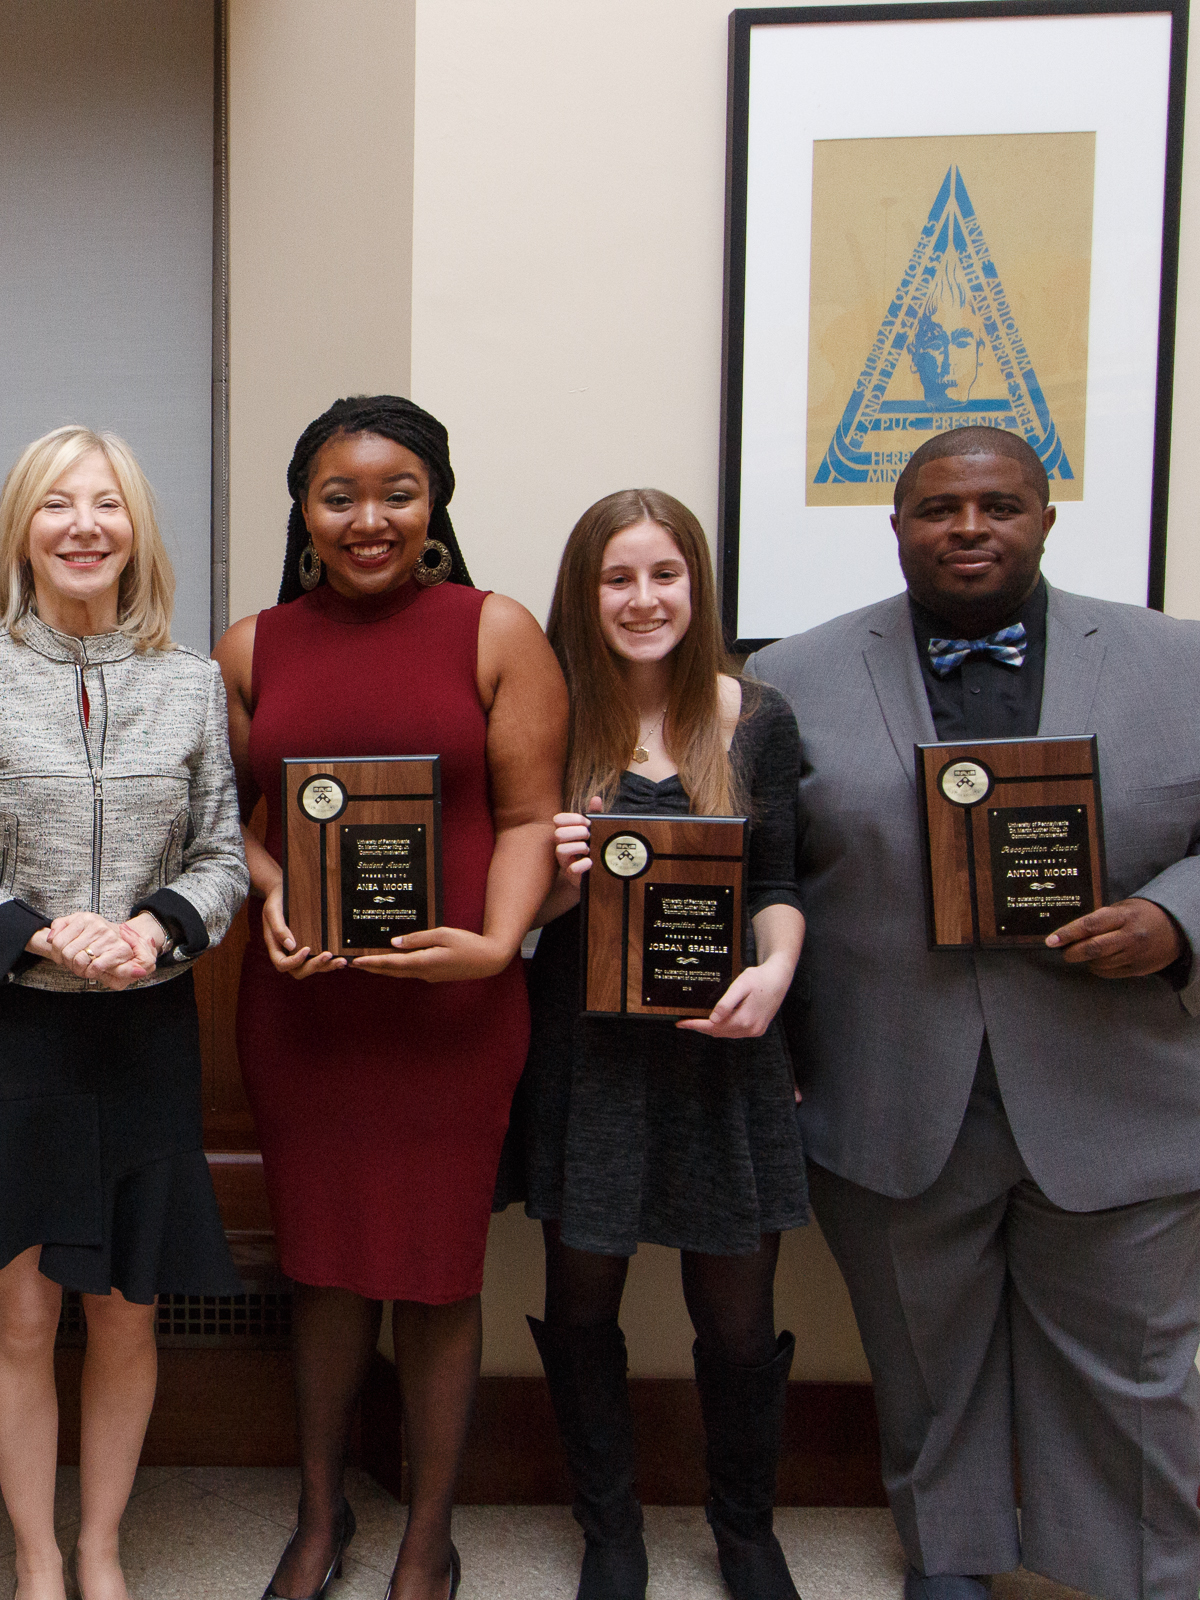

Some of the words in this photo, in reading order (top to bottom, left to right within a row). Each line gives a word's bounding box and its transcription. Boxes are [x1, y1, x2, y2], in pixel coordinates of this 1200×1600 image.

[894, 234, 931, 304] OCTOBER
[925, 220, 938, 231] 5
[964, 216, 992, 266] IRVINE
[986, 278, 1032, 372] AUDITORIUM
[958, 249, 980, 284] 34TH
[973, 291, 994, 324] AND
[988, 330, 1019, 385] SPRUCE
[1011, 391, 1039, 440] STREET
[853, 430, 865, 442] 8
[862, 391, 882, 427] AND
[885, 348, 903, 373] PM
[910, 274, 932, 309] AND
[881, 417, 916, 431] PUC
[932, 415, 1006, 431] PRESENTS
[872, 451, 913, 466] HERB
[867, 469, 901, 483] MIN
[1001, 845, 1047, 855] Recognition
[1007, 869, 1038, 877] ANTON
[1044, 868, 1078, 876] MOORE
[357, 883, 378, 891] ANEA
[654, 920, 695, 930] Recognition
[649, 943, 682, 951] JORDAN
[688, 945, 728, 953] GRABELLE
